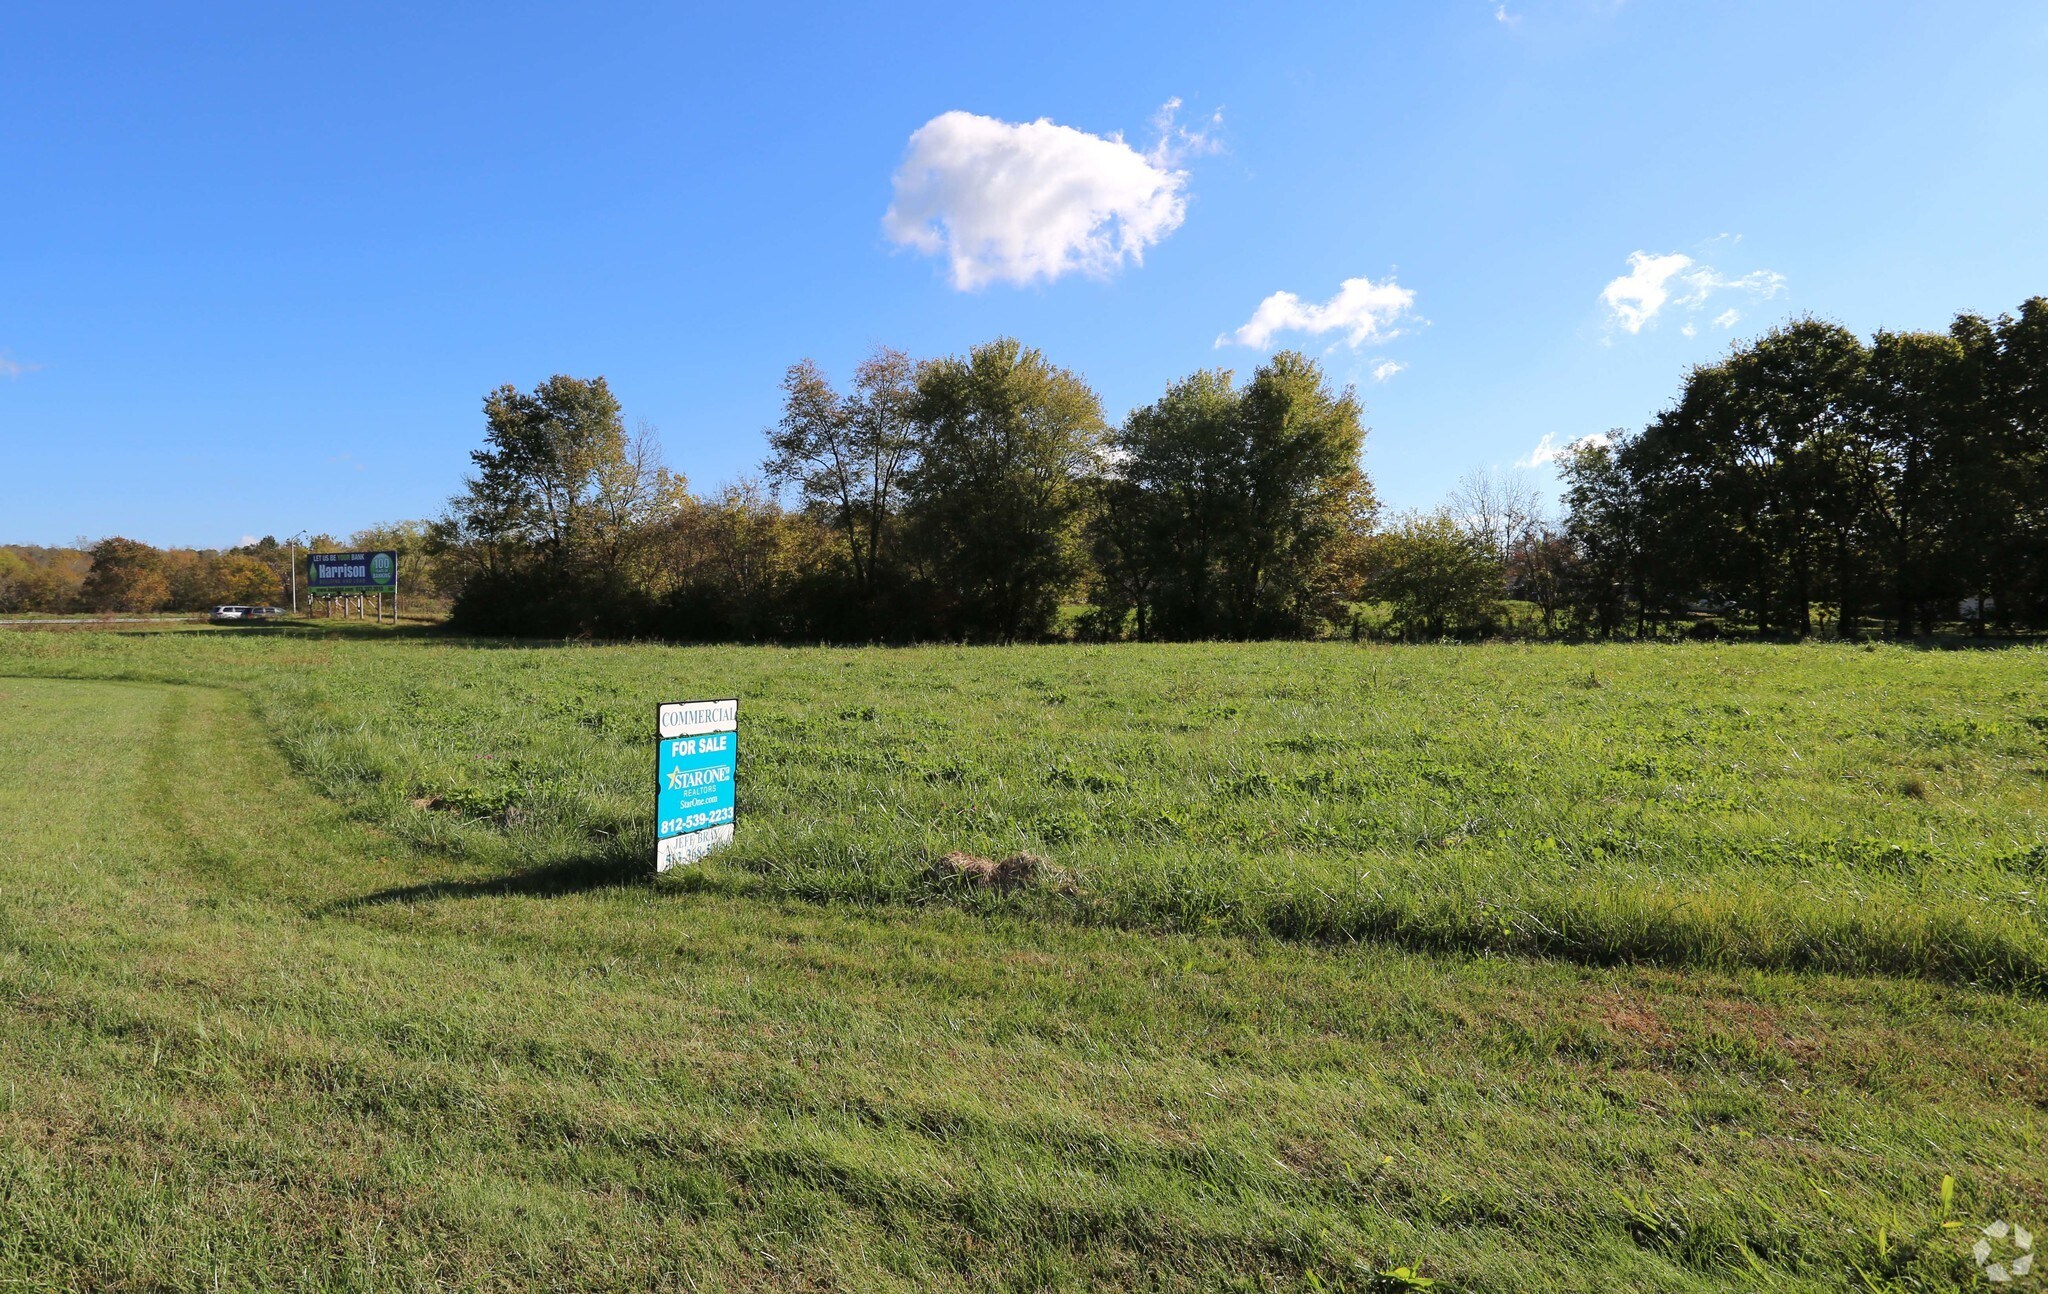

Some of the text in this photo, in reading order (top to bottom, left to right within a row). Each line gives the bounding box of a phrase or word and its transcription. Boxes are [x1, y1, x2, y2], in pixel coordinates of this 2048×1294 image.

[351, 553, 364, 561] BANK
[374, 559, 390, 568] 100
[319, 564, 366, 578] Harrison
[662, 707, 736, 727] COMMERCIAL
[672, 736, 727, 758] FOR SALE
[683, 785, 717, 797] REALTORS
[680, 796, 718, 810] StarOne.com
[660, 806, 734, 834] 812-539-2233
[674, 834, 694, 849] JEFF
